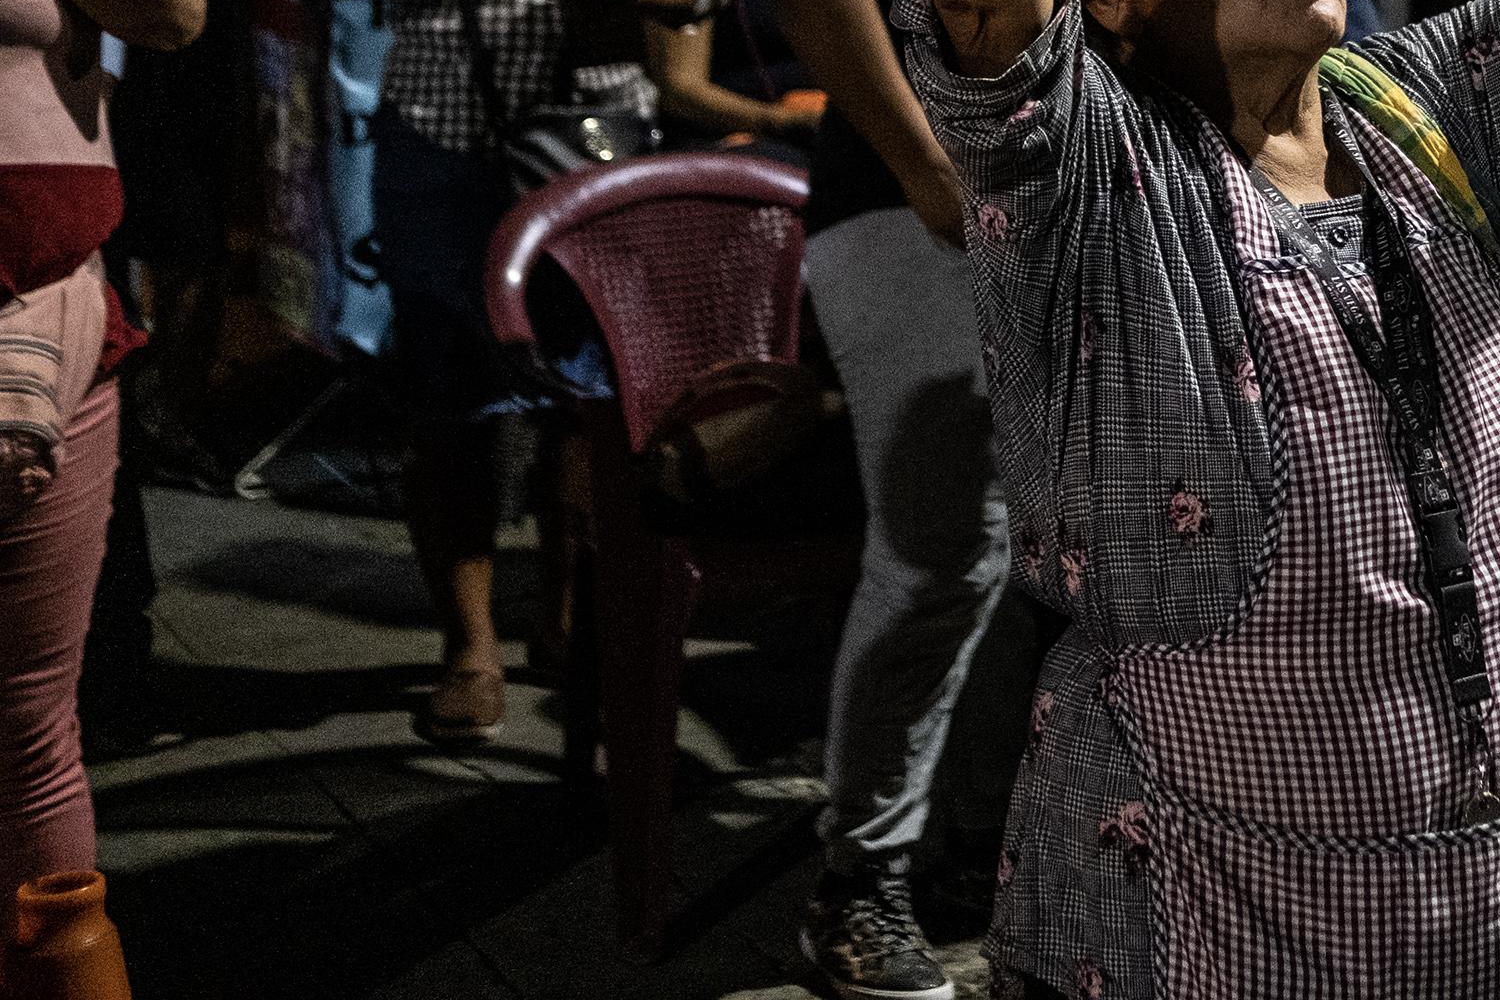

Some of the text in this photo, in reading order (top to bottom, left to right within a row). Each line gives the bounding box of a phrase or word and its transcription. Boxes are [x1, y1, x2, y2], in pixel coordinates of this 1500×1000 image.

[1263, 187, 1282, 202] LAS
[1275, 202, 1304, 230] VEGAS
[1331, 276, 1346, 293] LAS
[1343, 294, 1364, 324] VEGAS
[1390, 316, 1410, 370] LAS VEGAS
[1388, 377, 1420, 430] LAS VEGAS
